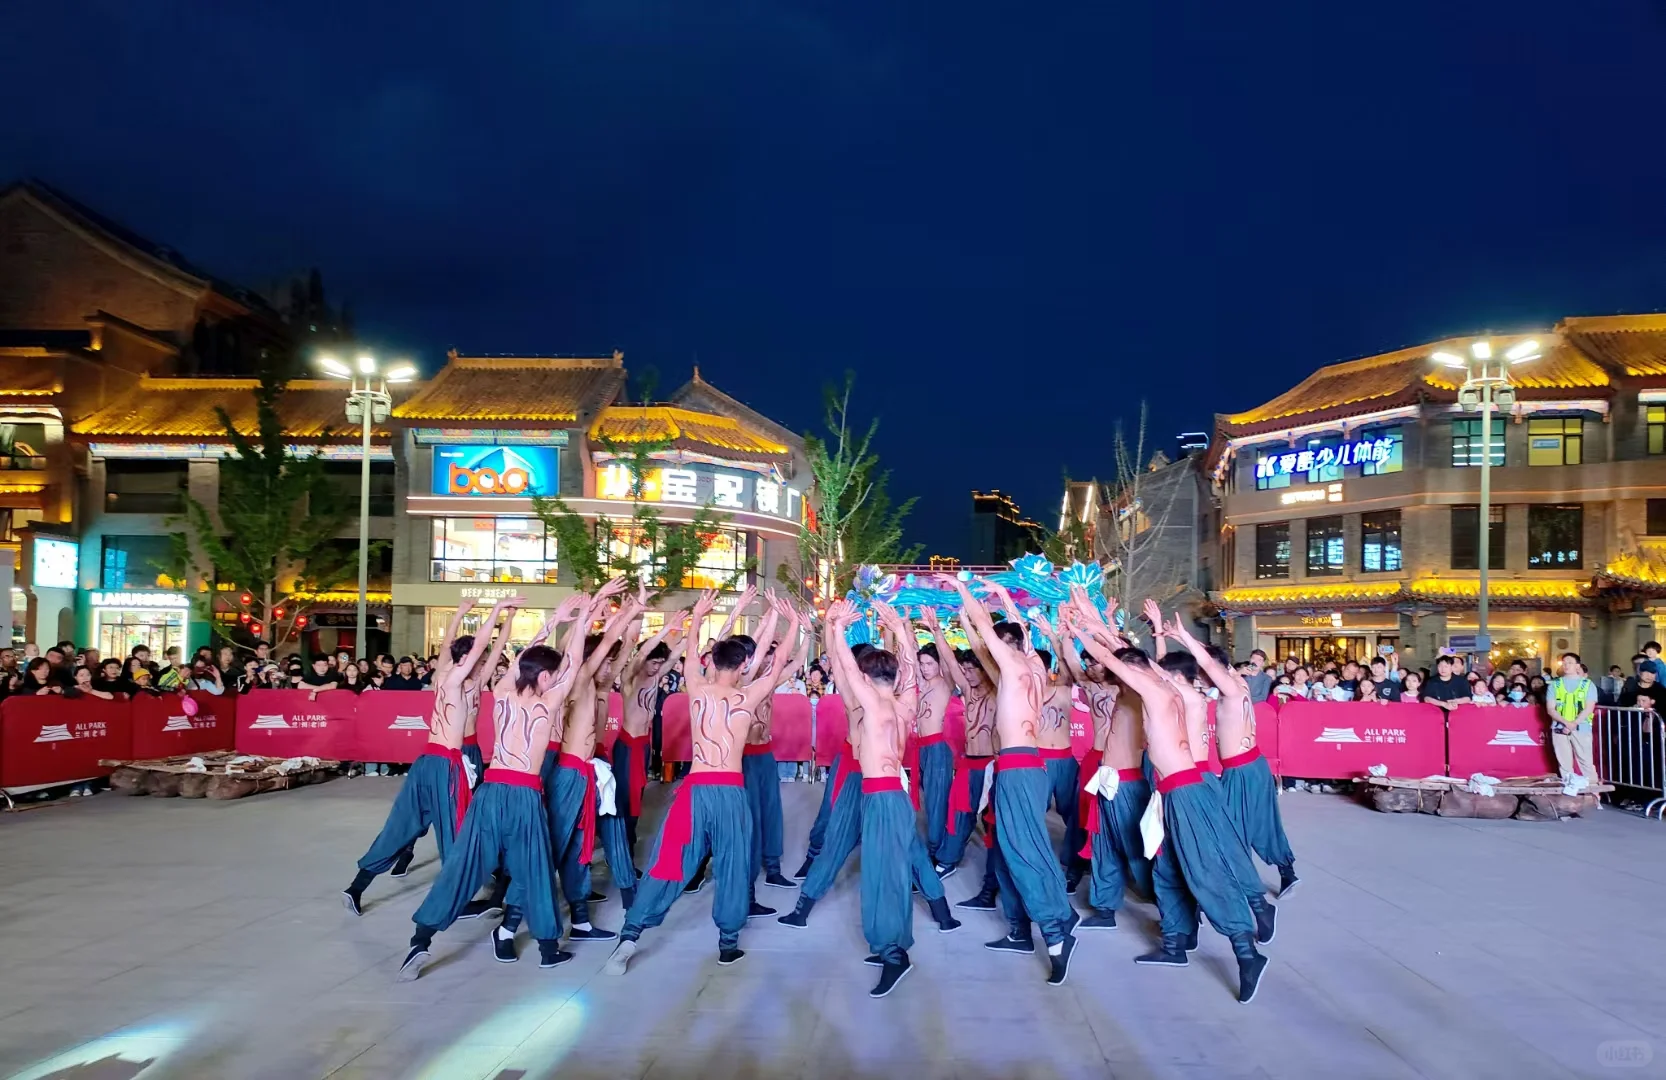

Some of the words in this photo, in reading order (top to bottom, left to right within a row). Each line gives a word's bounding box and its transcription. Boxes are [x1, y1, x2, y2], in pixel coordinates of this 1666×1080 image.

[1279, 438, 1394, 474] 爱酷少儿体能
[1382, 728, 1406, 736] PARK
